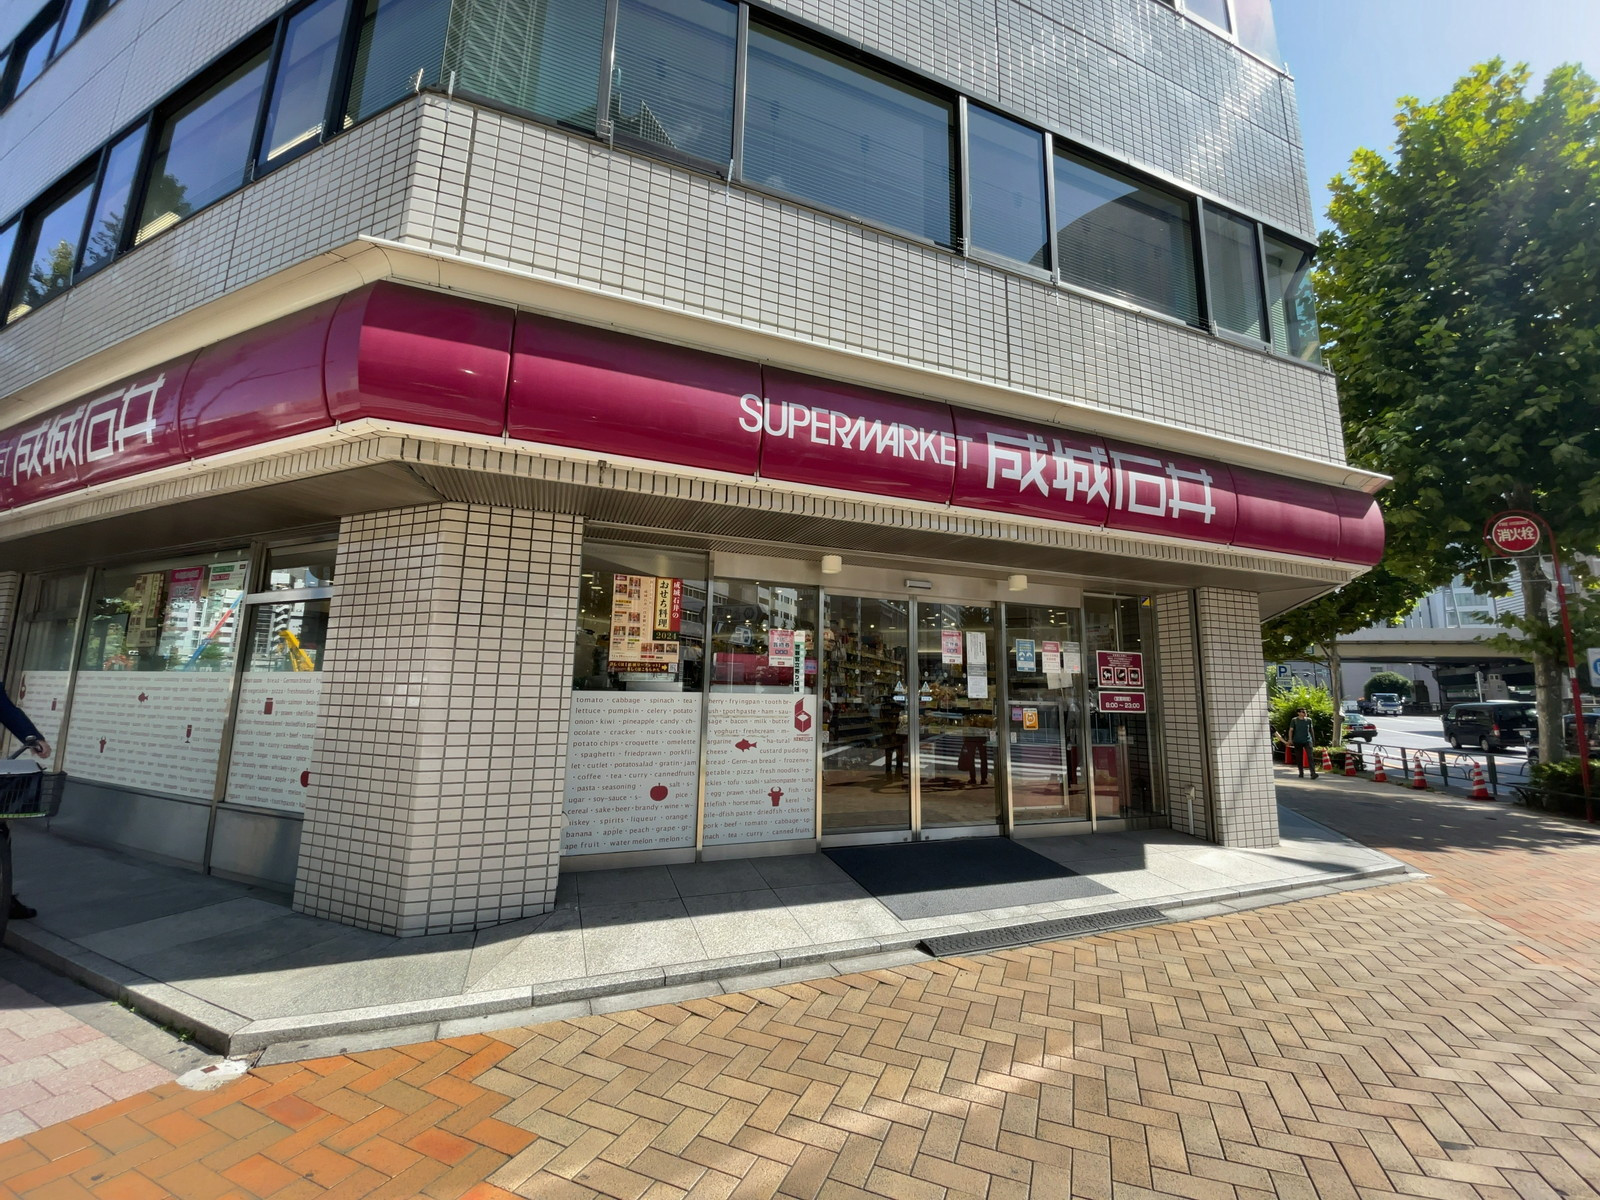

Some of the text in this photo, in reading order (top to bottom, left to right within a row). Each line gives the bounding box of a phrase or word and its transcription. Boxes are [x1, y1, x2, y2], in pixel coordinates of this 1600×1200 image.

[13, 373, 166, 486] 成城石井
[739, 393, 1216, 524] SUPERMARKET 成城石井
[1496, 526, 1535, 543] 消火栓
[658, 580, 669, 628] おせち料理
[672, 581, 681, 618] 成城石井の
[1279, 666, 1287, 677] P
